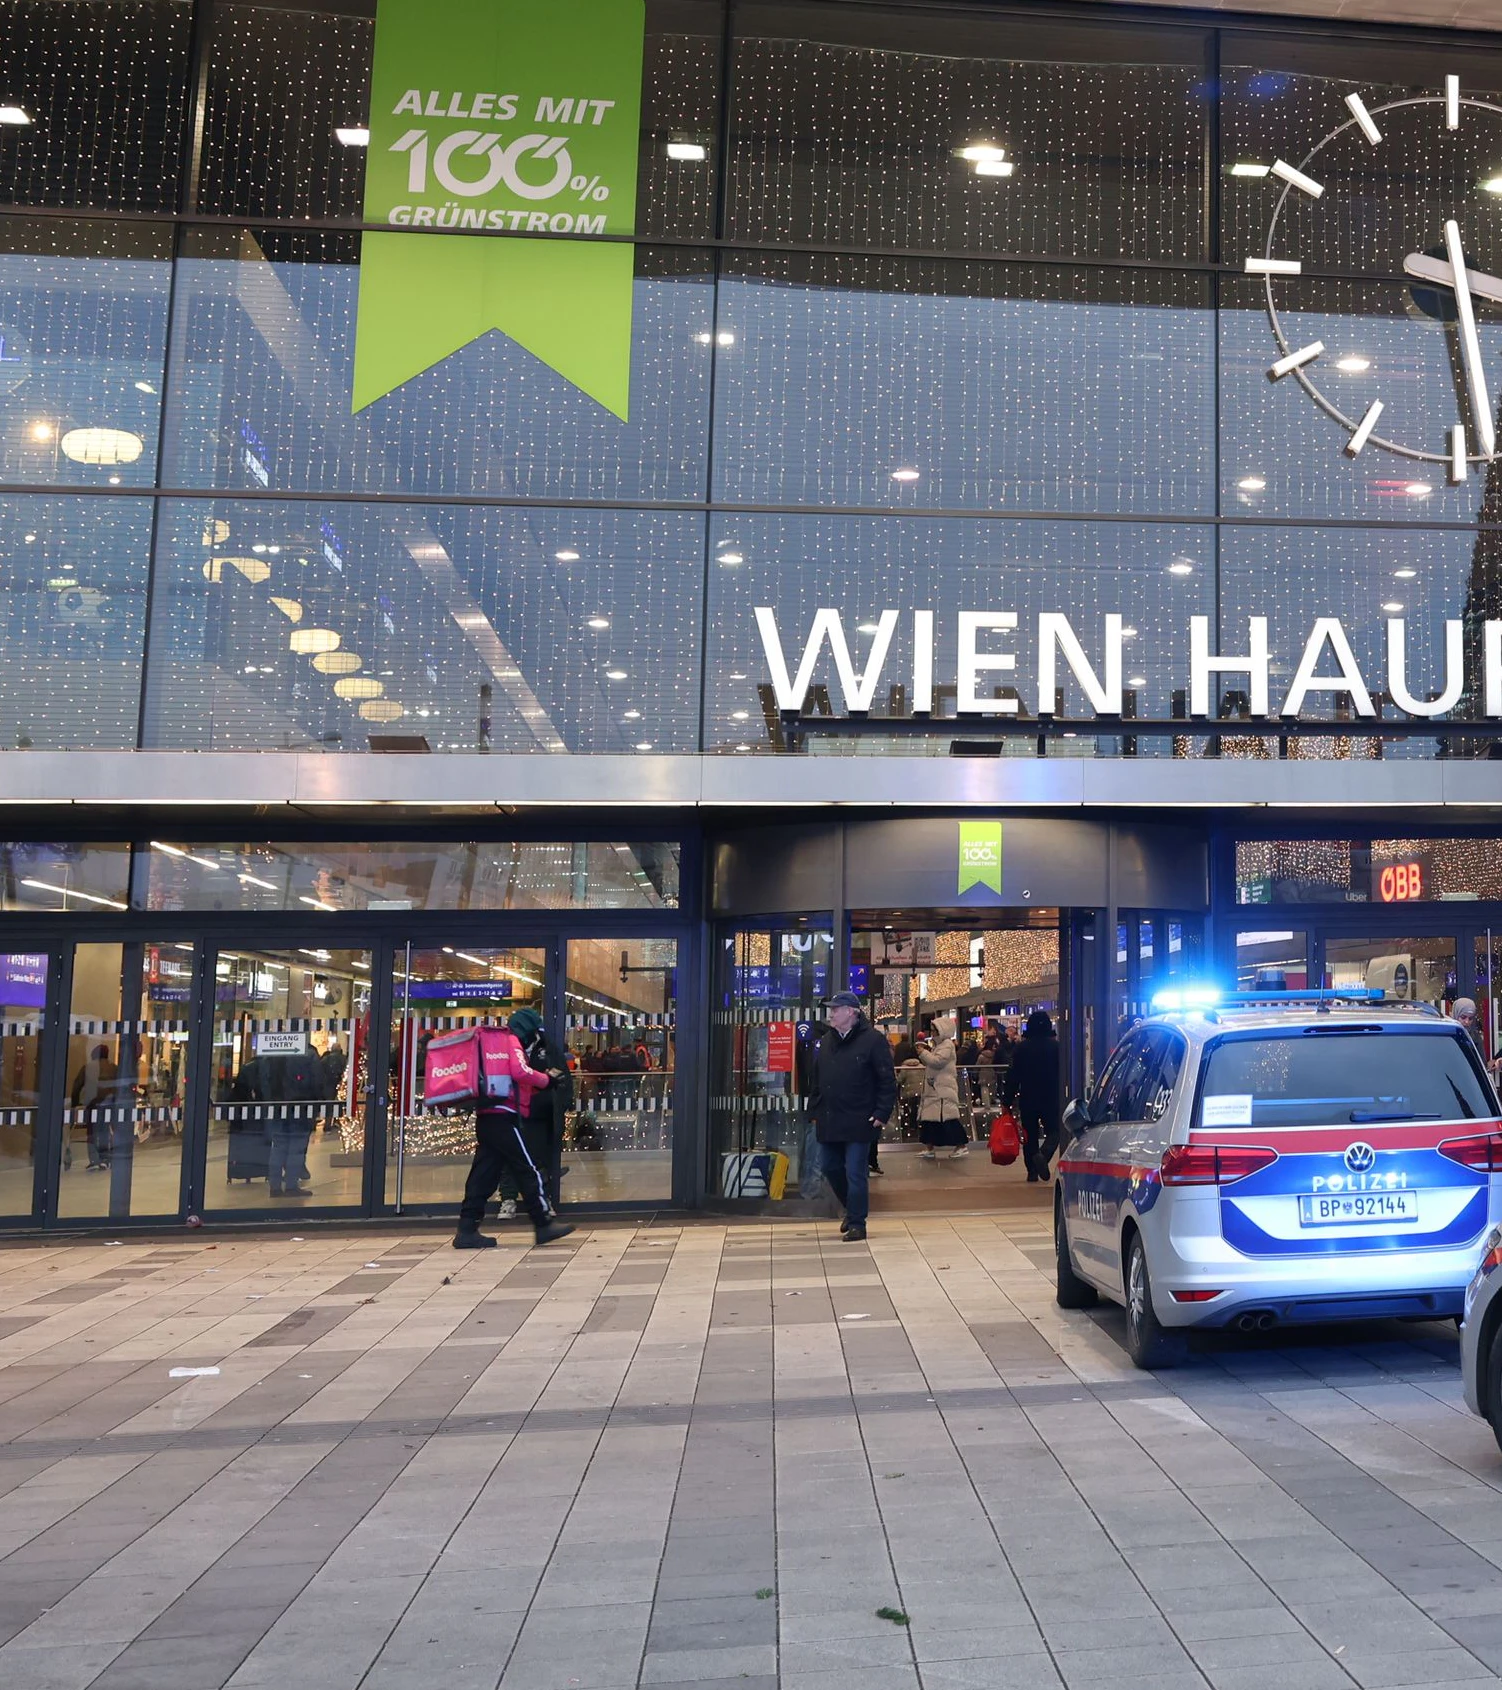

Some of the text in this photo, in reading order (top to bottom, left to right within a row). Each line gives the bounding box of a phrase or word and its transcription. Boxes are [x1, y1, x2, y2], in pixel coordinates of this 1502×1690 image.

[392, 89, 615, 125] ALLES MIT
[388, 129, 610, 201] 100%
[388, 202, 607, 234] GRÜNSTROM
[754, 606, 1123, 715] WIEN
[1381, 863, 1421, 902] ÖBB
[264, 1034, 299, 1042] EINGANG
[1312, 1172, 1407, 1192] POLIZEI
[1077, 1189, 1103, 1221] POLIZEI
[1355, 1196, 1406, 1215] 92144
